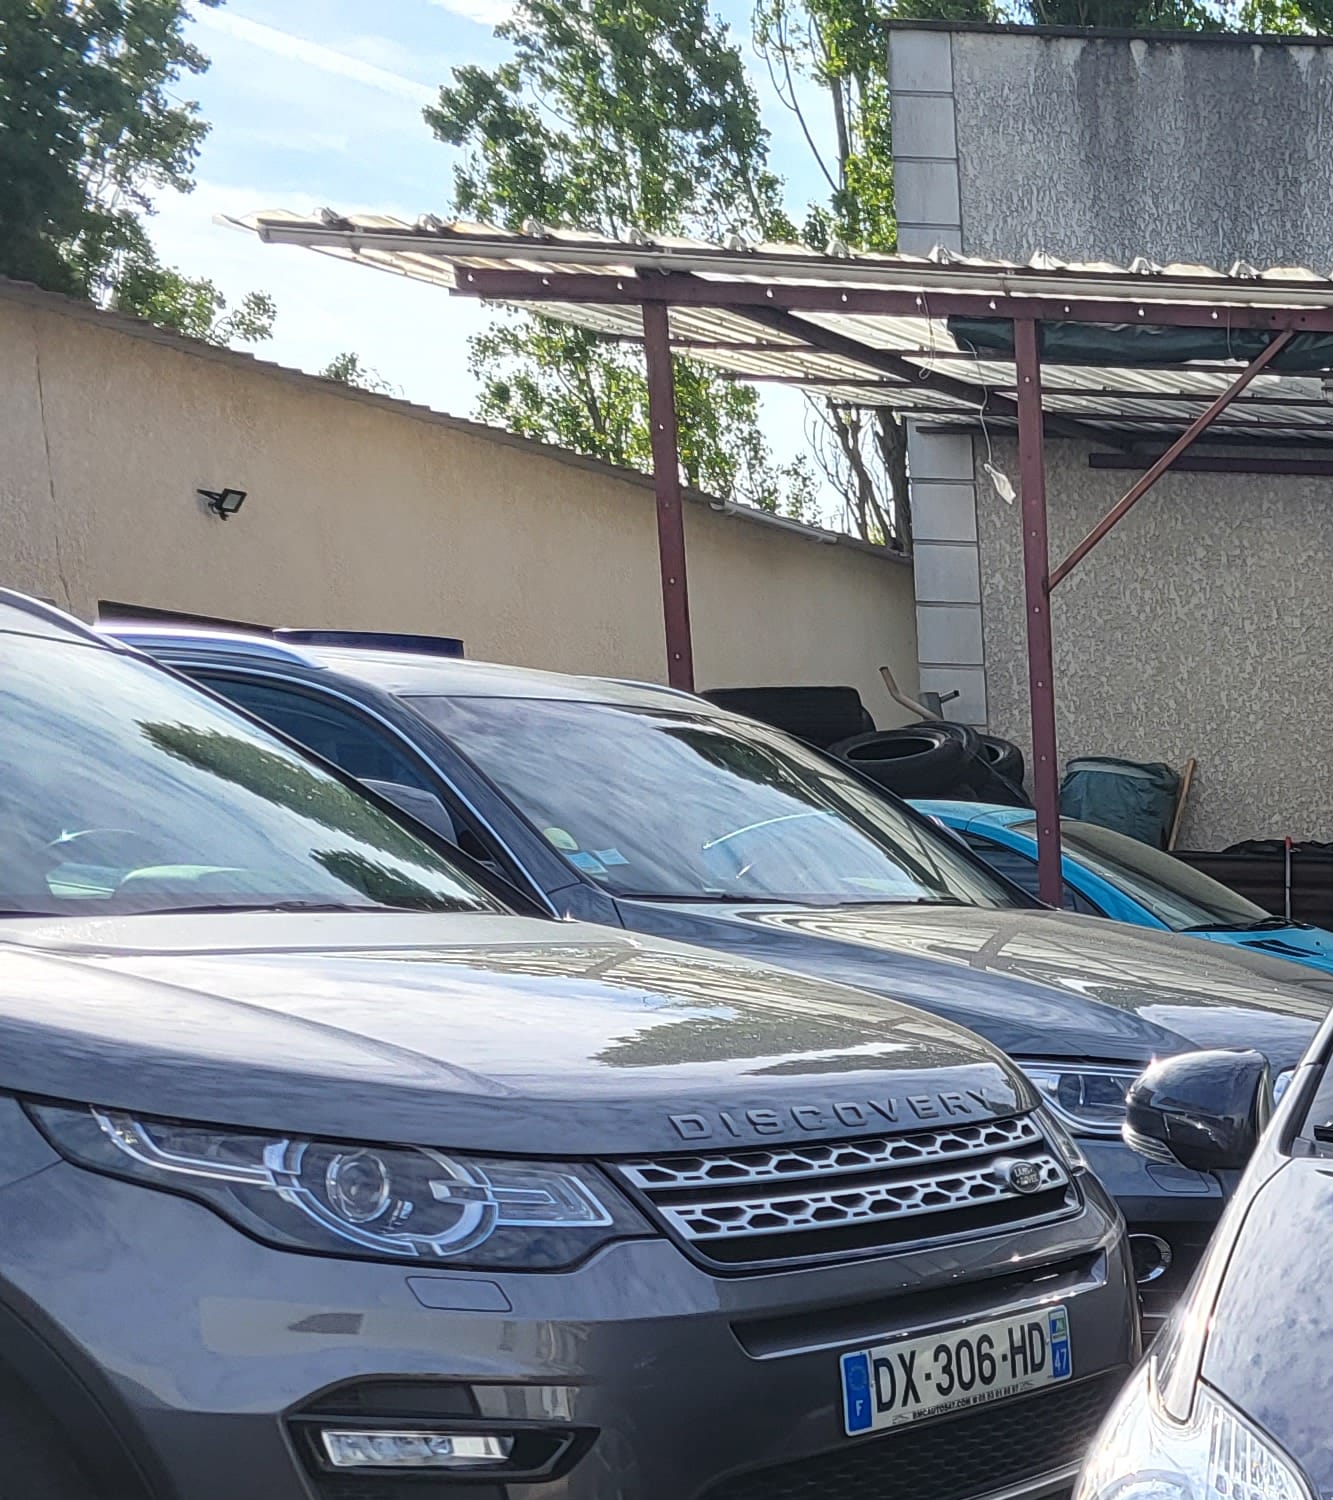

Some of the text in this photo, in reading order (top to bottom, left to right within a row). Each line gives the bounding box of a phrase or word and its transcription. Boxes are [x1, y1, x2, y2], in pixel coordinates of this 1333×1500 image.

[668, 1088, 993, 1141] DISCOVERY
[855, 1398, 864, 1417] F
[873, 1321, 1046, 1413] DX-306-HD
[1054, 1347, 1067, 1372] 47
